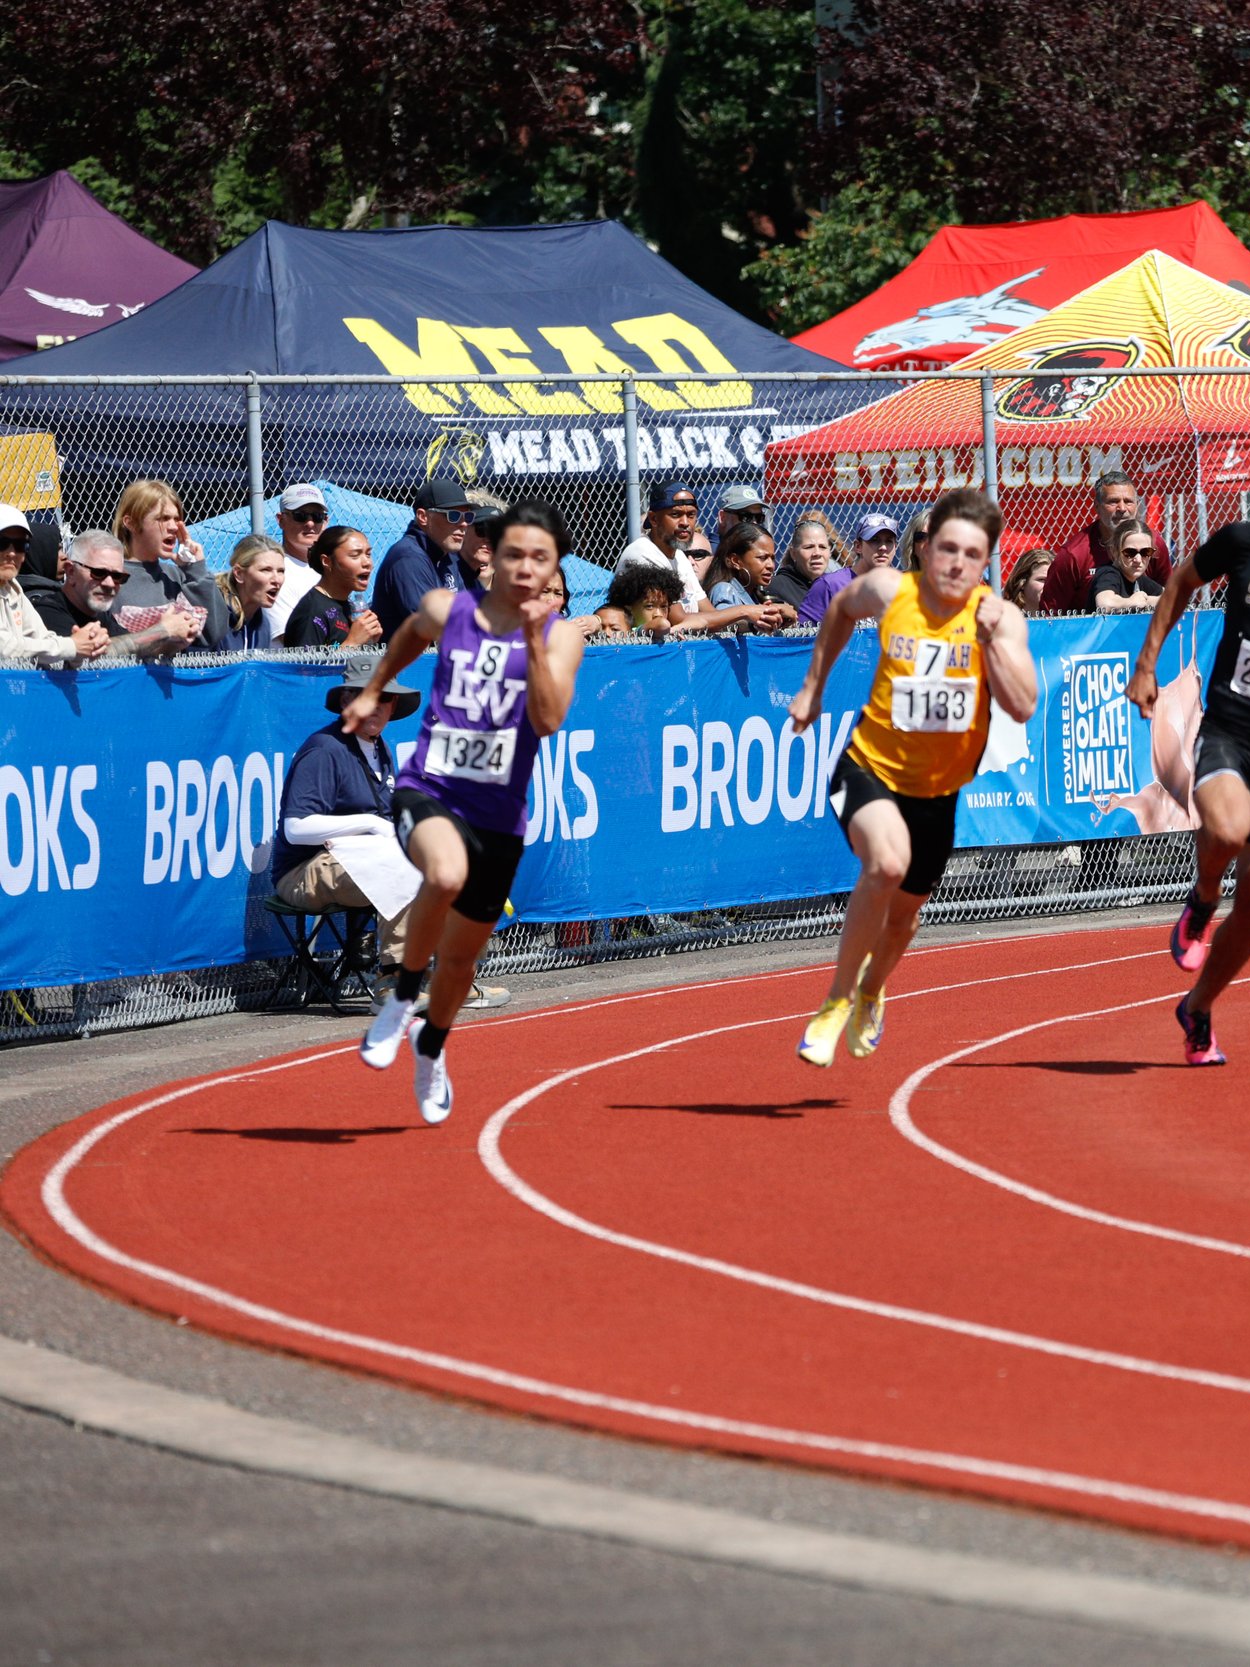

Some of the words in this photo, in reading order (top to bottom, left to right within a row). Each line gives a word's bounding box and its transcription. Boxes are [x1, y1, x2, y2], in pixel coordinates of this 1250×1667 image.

[342, 312, 753, 416] MEAD
[487, 430, 602, 475] MEAD
[602, 425, 738, 472] TRACK
[481, 645, 502, 676] 8
[925, 643, 943, 676] 7
[1060, 656, 1071, 683] BY
[904, 689, 966, 721] 1133
[1075, 662, 1126, 715] CHOC
[1076, 695, 1128, 750] OLATE
[442, 734, 504, 771] 1324
[1061, 691, 1073, 804] POWERED
[1078, 748, 1129, 792] MILK
